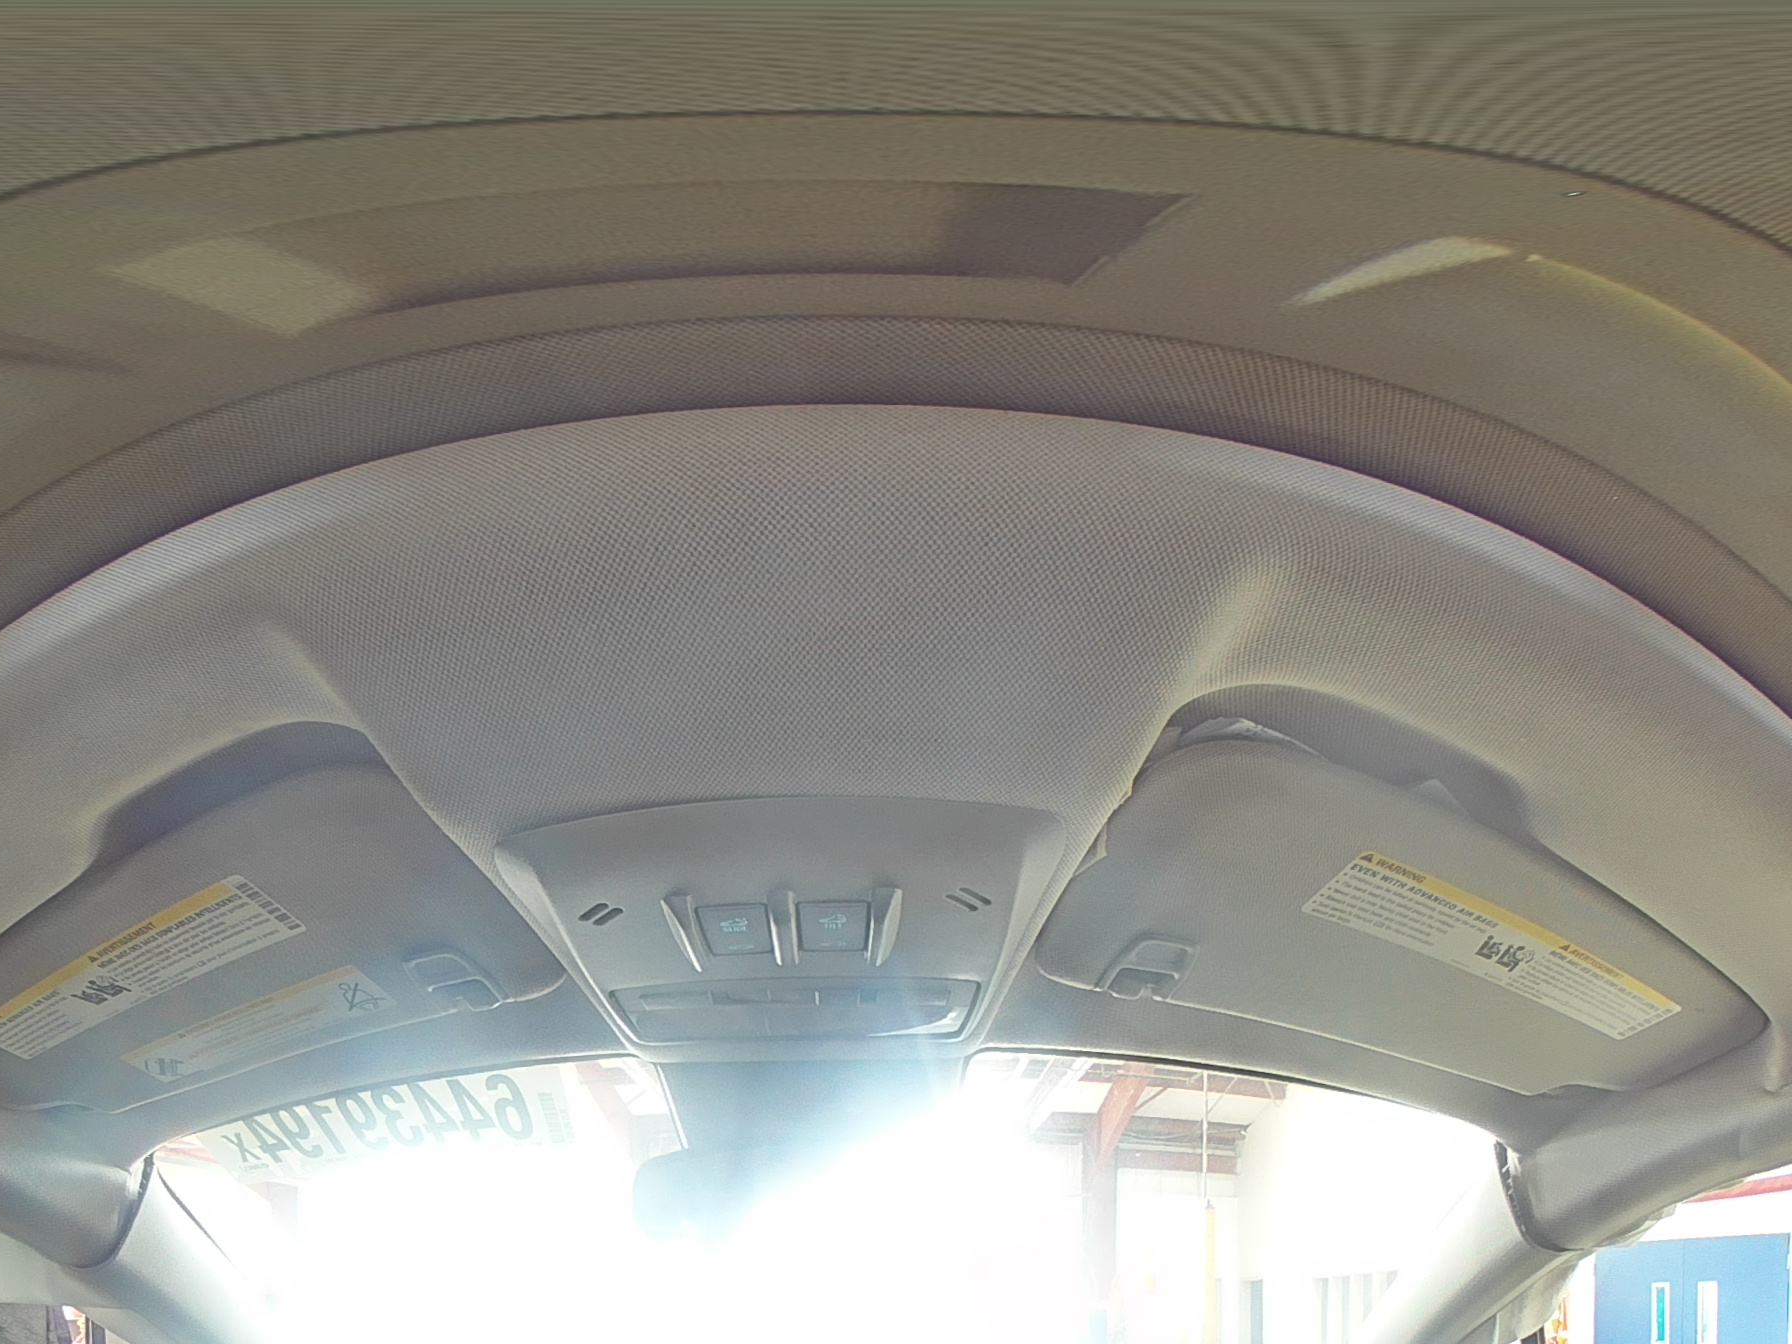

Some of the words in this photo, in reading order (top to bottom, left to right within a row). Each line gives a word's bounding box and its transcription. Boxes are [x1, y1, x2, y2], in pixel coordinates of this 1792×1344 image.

[1349, 863, 1380, 879] EVEN
[1379, 874, 1408, 890] WITH
[1376, 858, 1427, 884] WARNING
